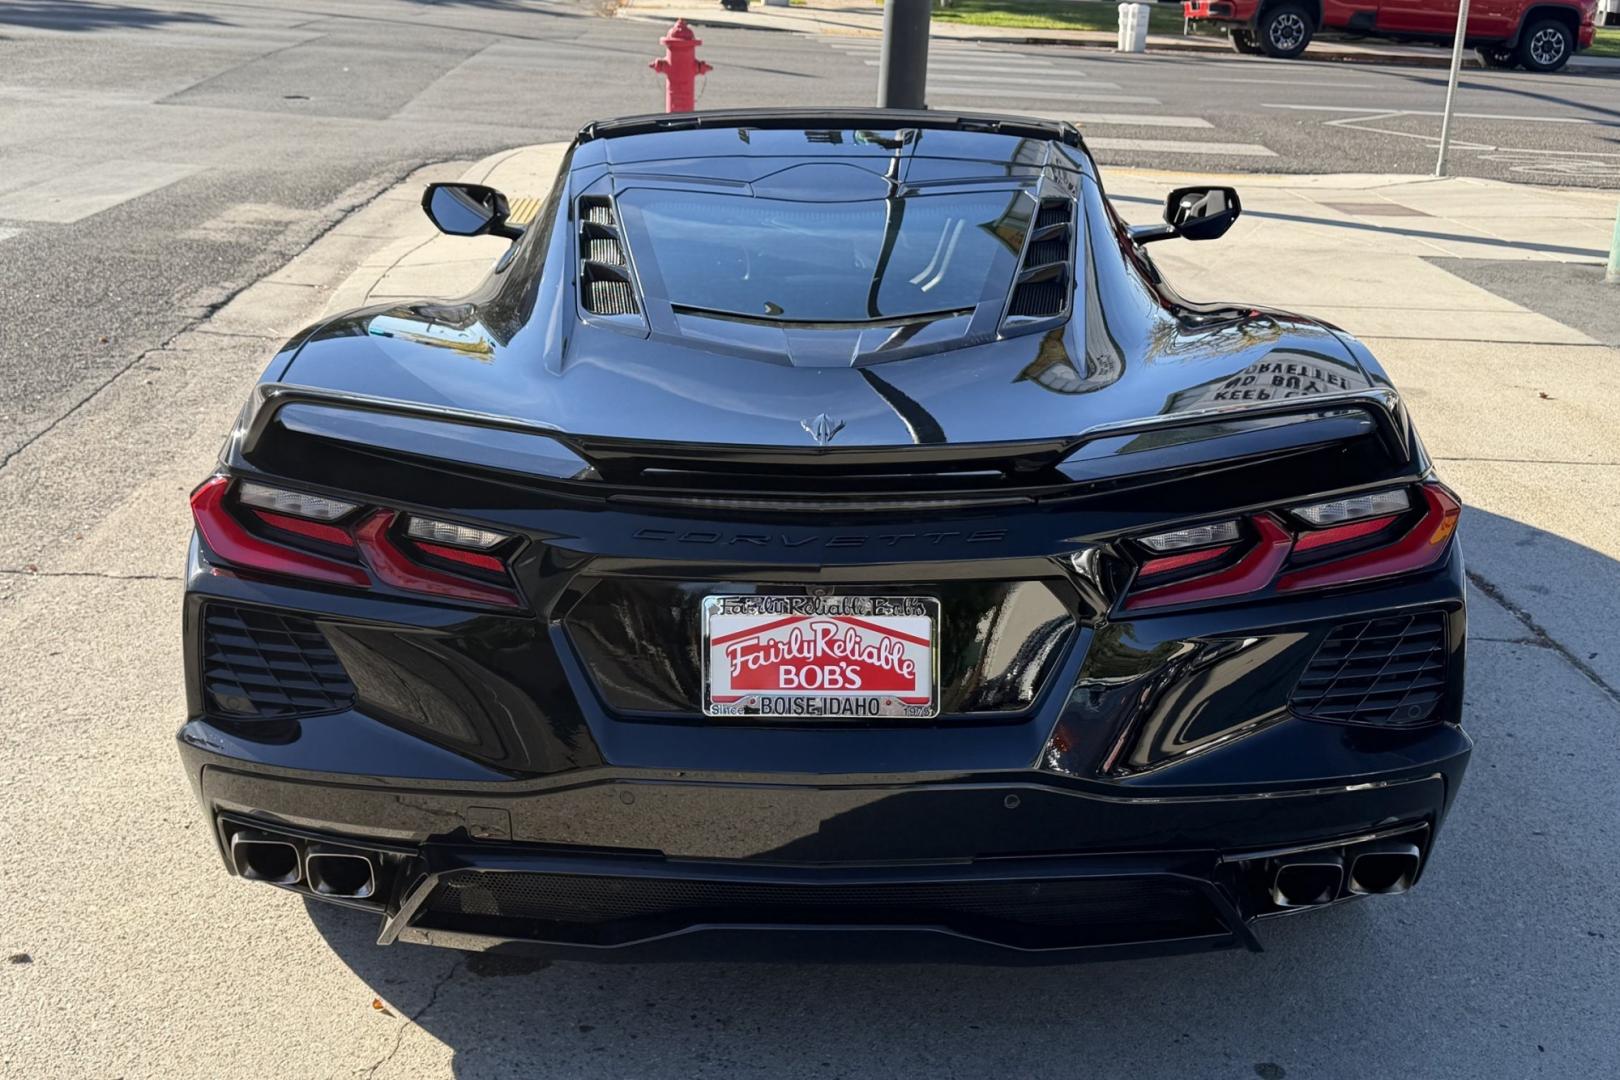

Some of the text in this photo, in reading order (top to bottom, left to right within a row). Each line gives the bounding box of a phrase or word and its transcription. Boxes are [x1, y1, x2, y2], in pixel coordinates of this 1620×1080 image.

[631, 527, 1009, 547] CORVETTE
[726, 620, 916, 680] Fairly Reliable
[779, 661, 862, 689] BOB'S
[822, 697, 880, 715] IDAHO
